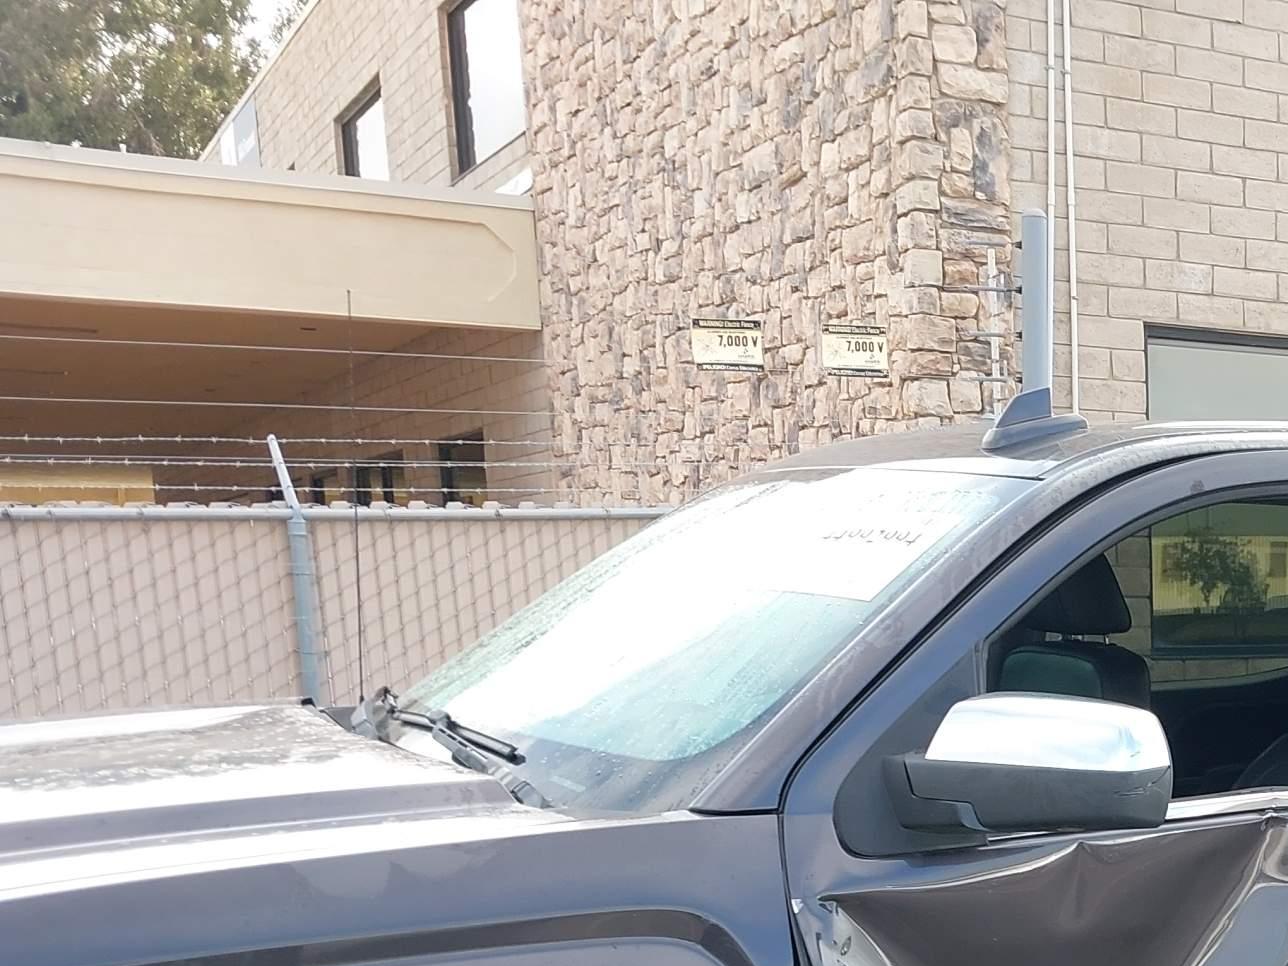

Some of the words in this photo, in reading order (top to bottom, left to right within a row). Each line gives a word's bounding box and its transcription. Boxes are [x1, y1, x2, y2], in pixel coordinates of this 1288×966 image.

[718, 335, 748, 348] 7,000
[751, 335, 759, 348] V
[846, 340, 874, 353] 7,000
[877, 341, 884, 353] V
